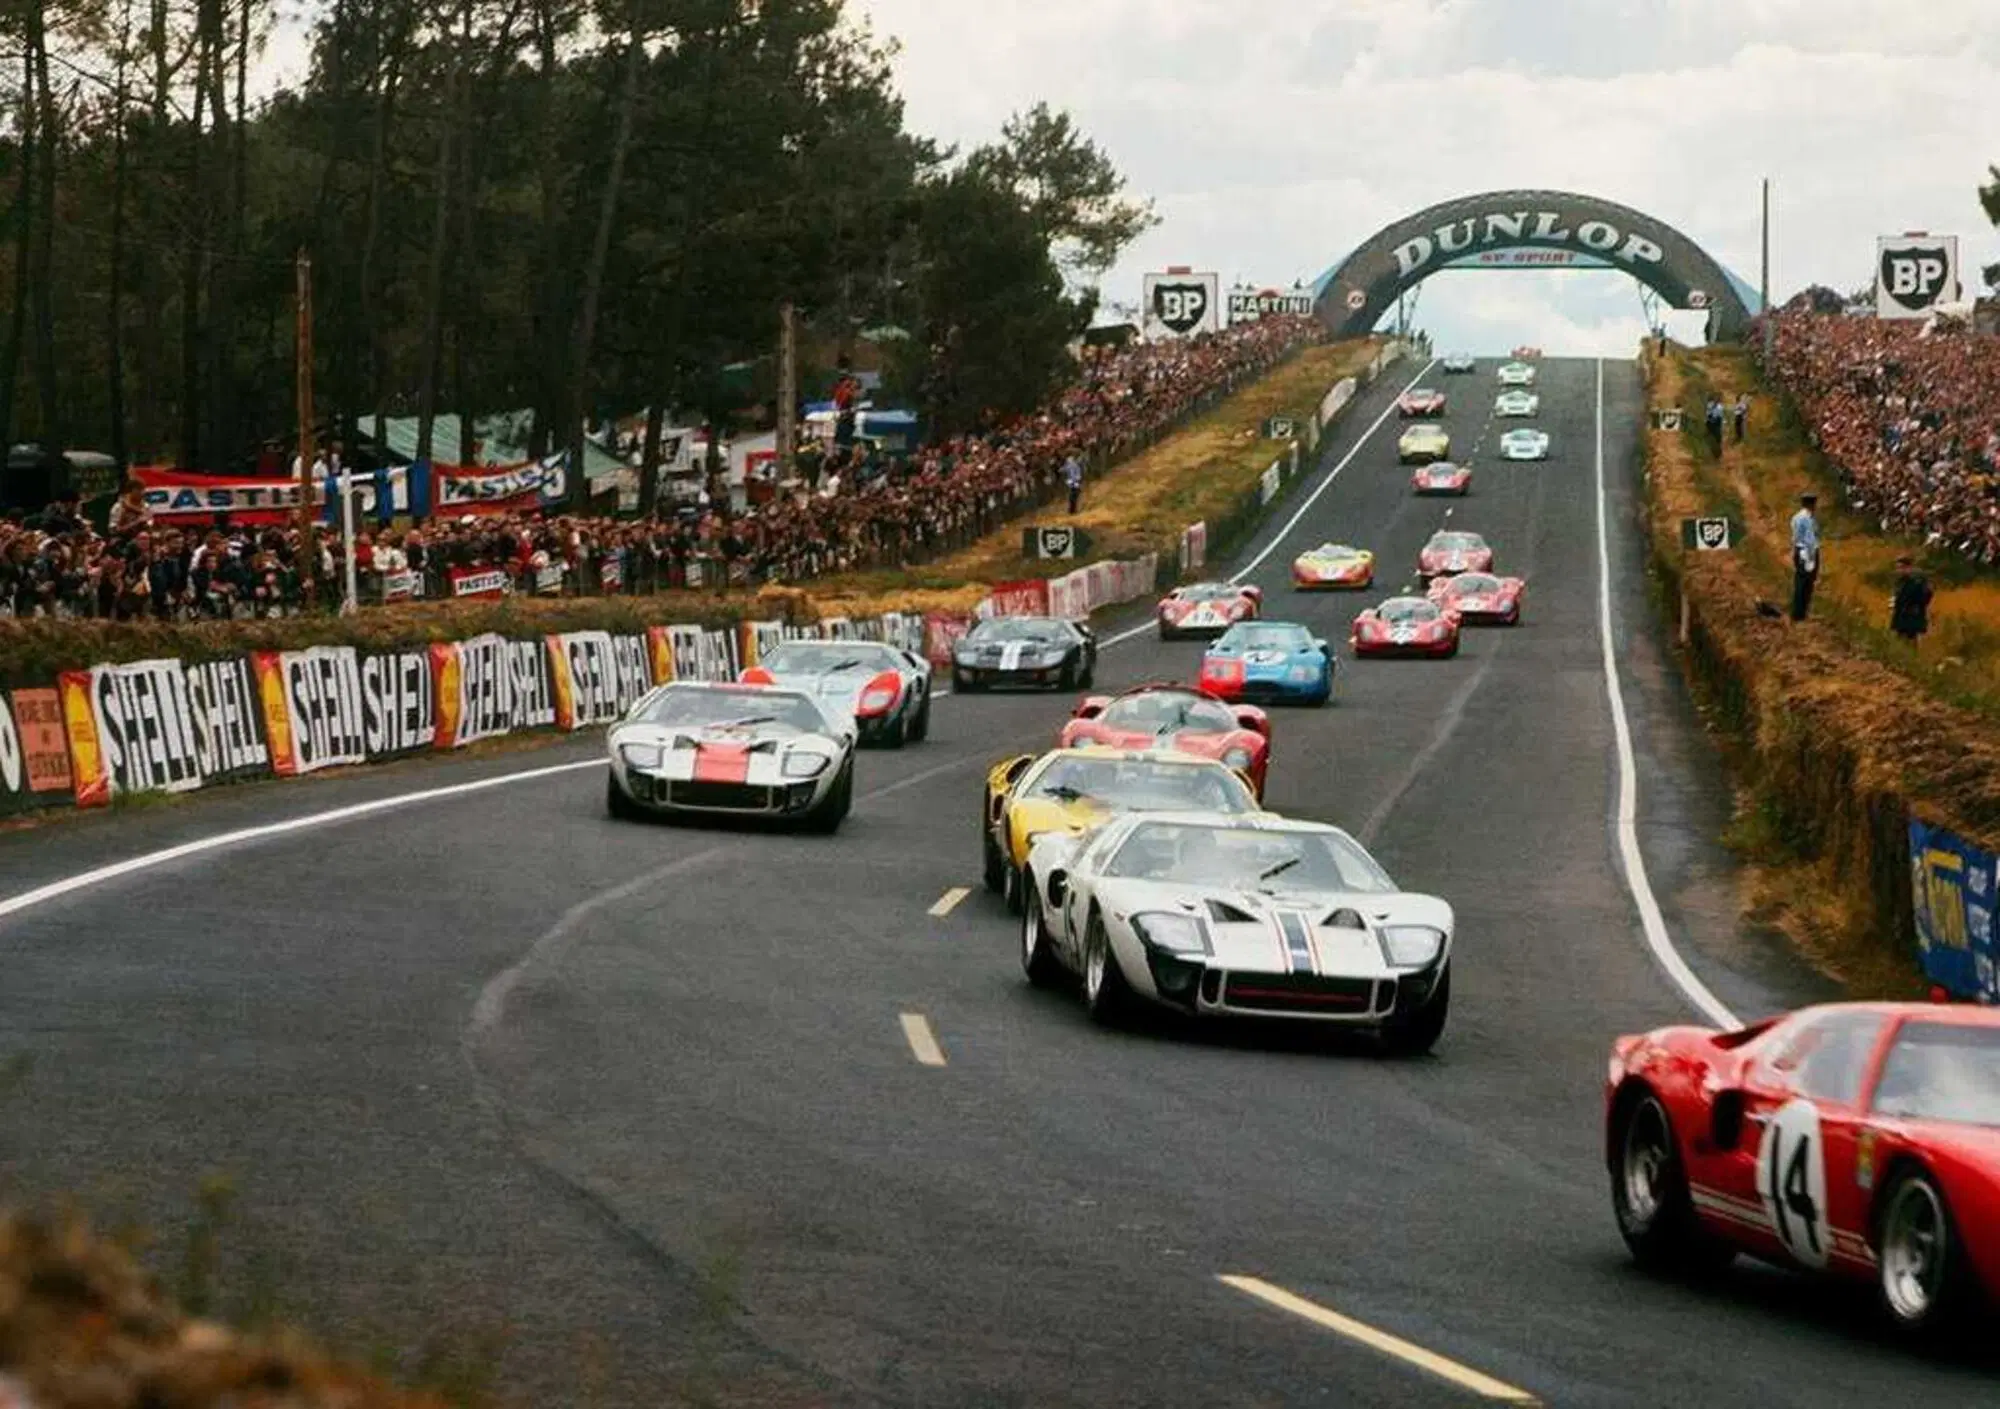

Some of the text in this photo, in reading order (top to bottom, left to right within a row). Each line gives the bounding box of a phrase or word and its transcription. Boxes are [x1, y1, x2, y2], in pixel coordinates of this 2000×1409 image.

[1393, 212, 1663, 278] DUNLOP
[1891, 259, 1942, 295] BP
[1162, 291, 1204, 322] BP
[1046, 532, 1069, 550] BP
[1703, 523, 1724, 541] BP
[290, 653, 436, 762] SHELL SHELL
[462, 644, 509, 738] SHELL
[100, 670, 197, 793] SHELL
[187, 658, 268, 776] SHELL
[1771, 1122, 1821, 1255] 14
